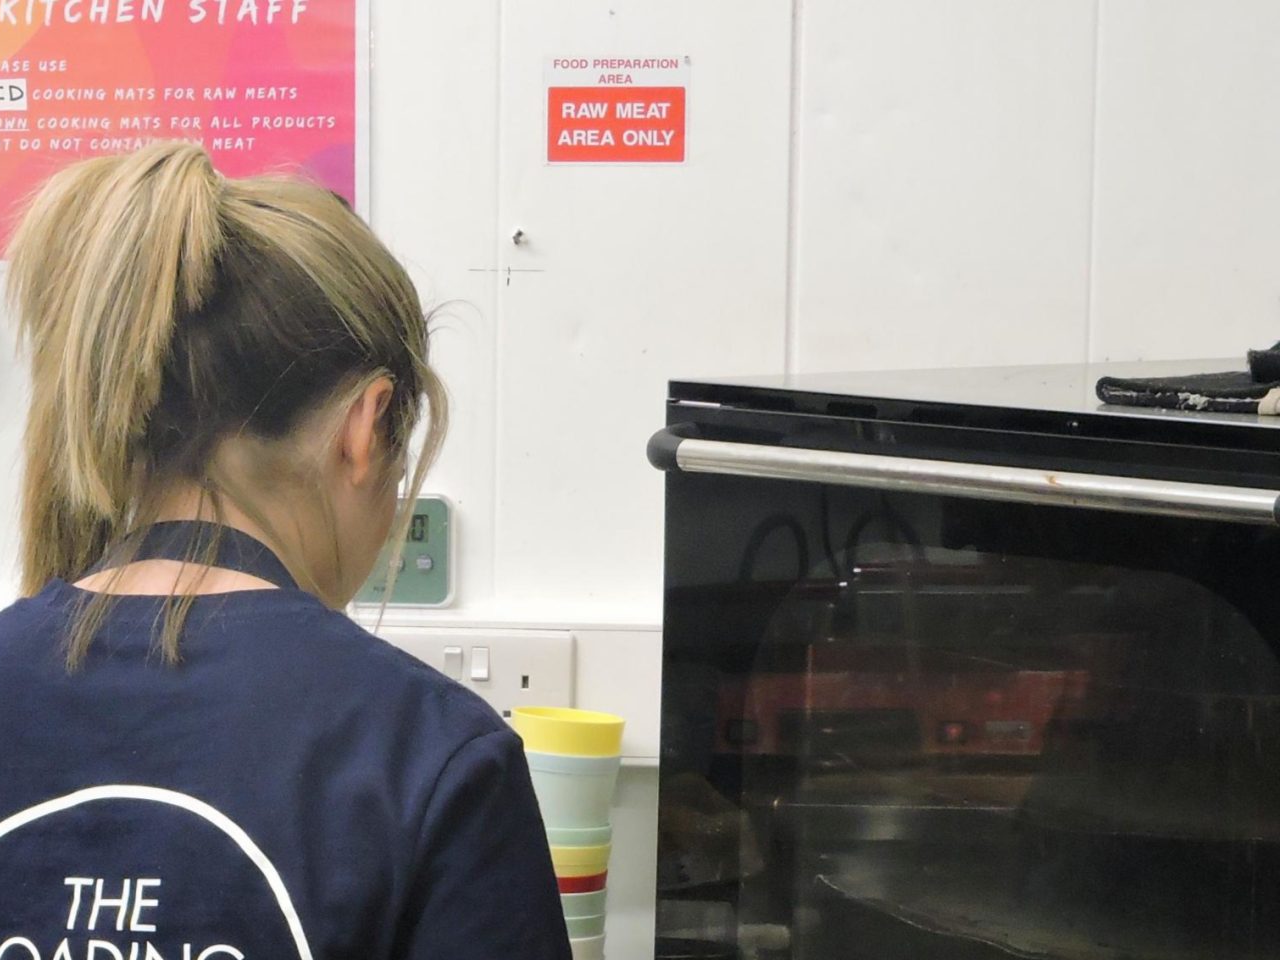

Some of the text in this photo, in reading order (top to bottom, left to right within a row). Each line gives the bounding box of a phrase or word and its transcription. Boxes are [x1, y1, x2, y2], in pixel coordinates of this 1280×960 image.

[188, 0, 309, 25] STAFF
[38, 60, 68, 72] USE
[553, 59, 679, 69] FOOD PREPARATION
[598, 74, 633, 84] AREA
[32, 87, 106, 101] COOKING
[114, 87, 156, 101] MATS
[164, 87, 196, 100] FOR
[203, 87, 237, 100] RAW
[245, 87, 299, 100] MEATS
[561, 103, 672, 119] RAW MEAT
[37, 116, 111, 130] COOKING
[120, 116, 161, 130] MATS
[170, 116, 202, 130] FOR
[211, 116, 243, 129] ALL
[252, 115, 337, 129] PRODUCTS
[20, 138, 41, 151] DO
[49, 138, 82, 151] NOT
[213, 137, 256, 150] MEAT
[558, 130, 675, 146] AREA ONLY
[64, 877, 162, 932] THE
